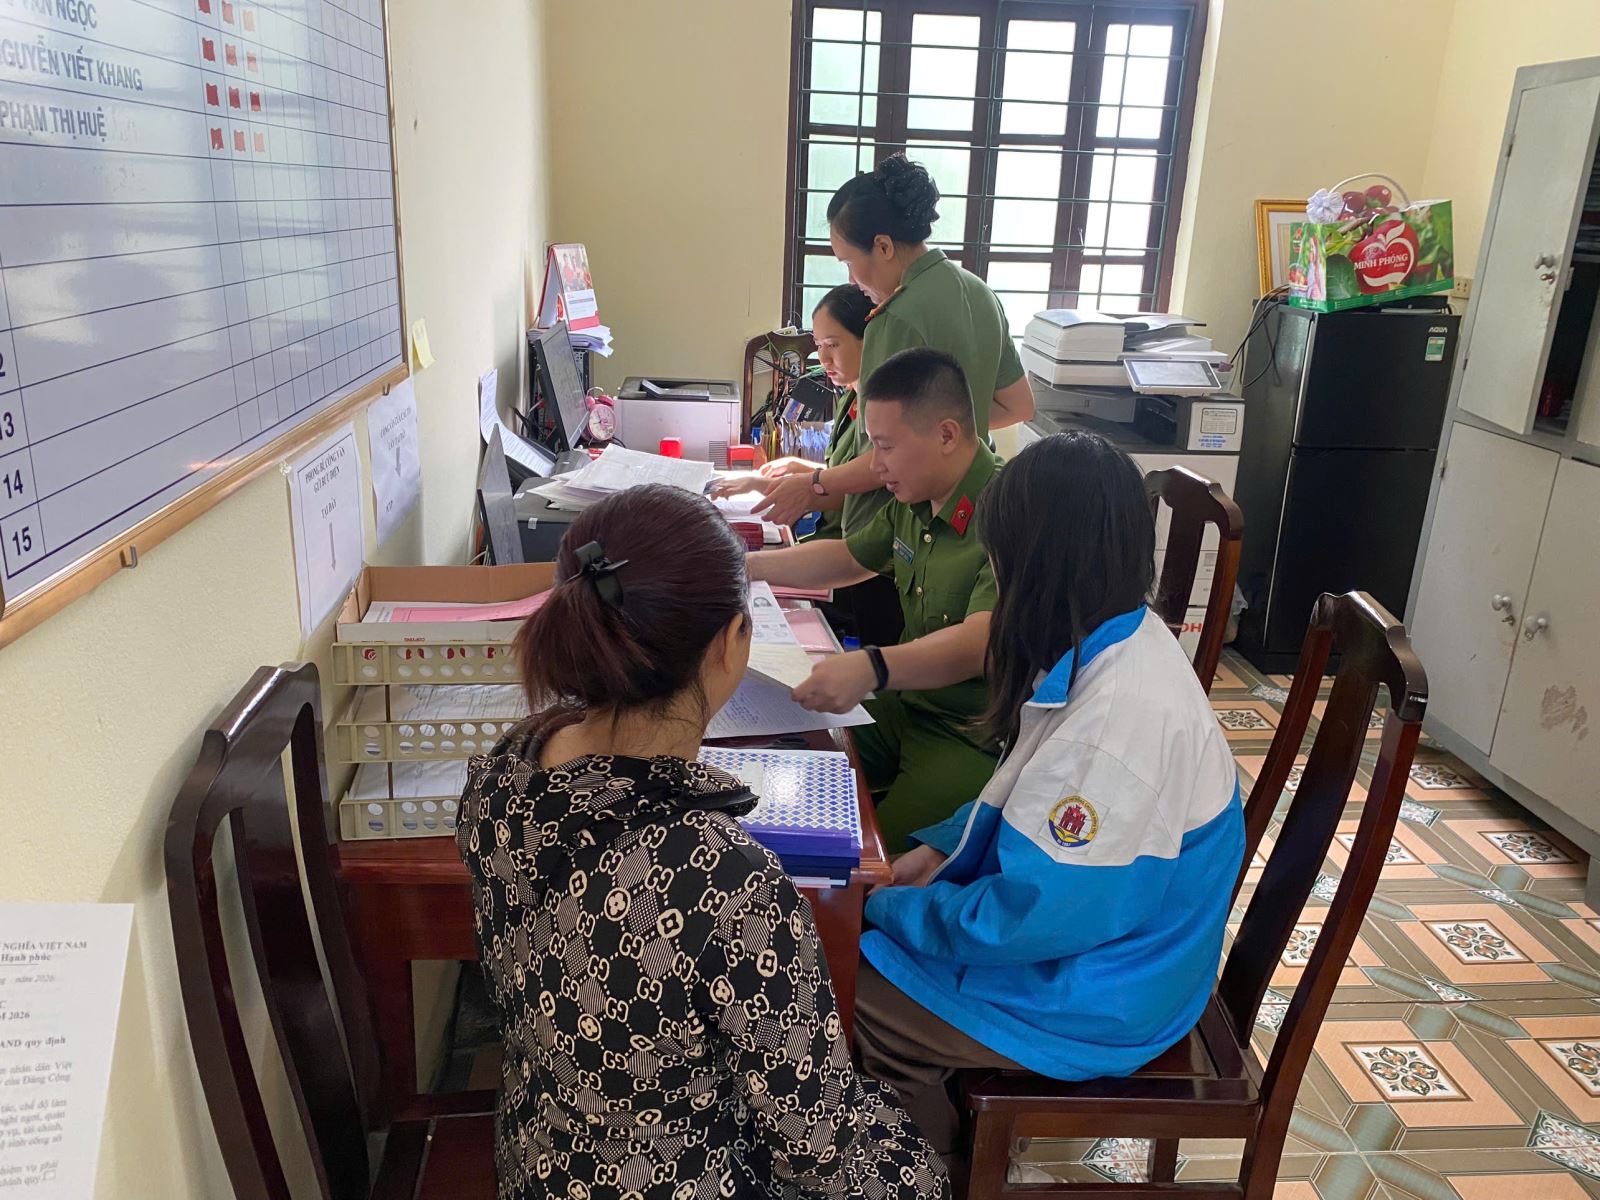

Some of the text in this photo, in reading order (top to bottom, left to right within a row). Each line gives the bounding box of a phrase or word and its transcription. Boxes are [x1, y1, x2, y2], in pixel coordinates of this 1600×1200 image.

[57, 0, 98, 31] NGỌC
[0, 35, 144, 91] GUYỄN VIẾT KHANG
[0, 100, 107, 142] PHẠM THỊ HUỆ
[1354, 258, 1377, 270] MINH
[3, 469, 24, 499] 14
[12, 526, 32, 556] 15
[3, 940, 88, 951] NGHĨA VIỆT NAM
[1, 952, 52, 963] Hạnh phúc
[8, 1010, 31, 1020] 2026
[25, 1039, 42, 1049] quy
